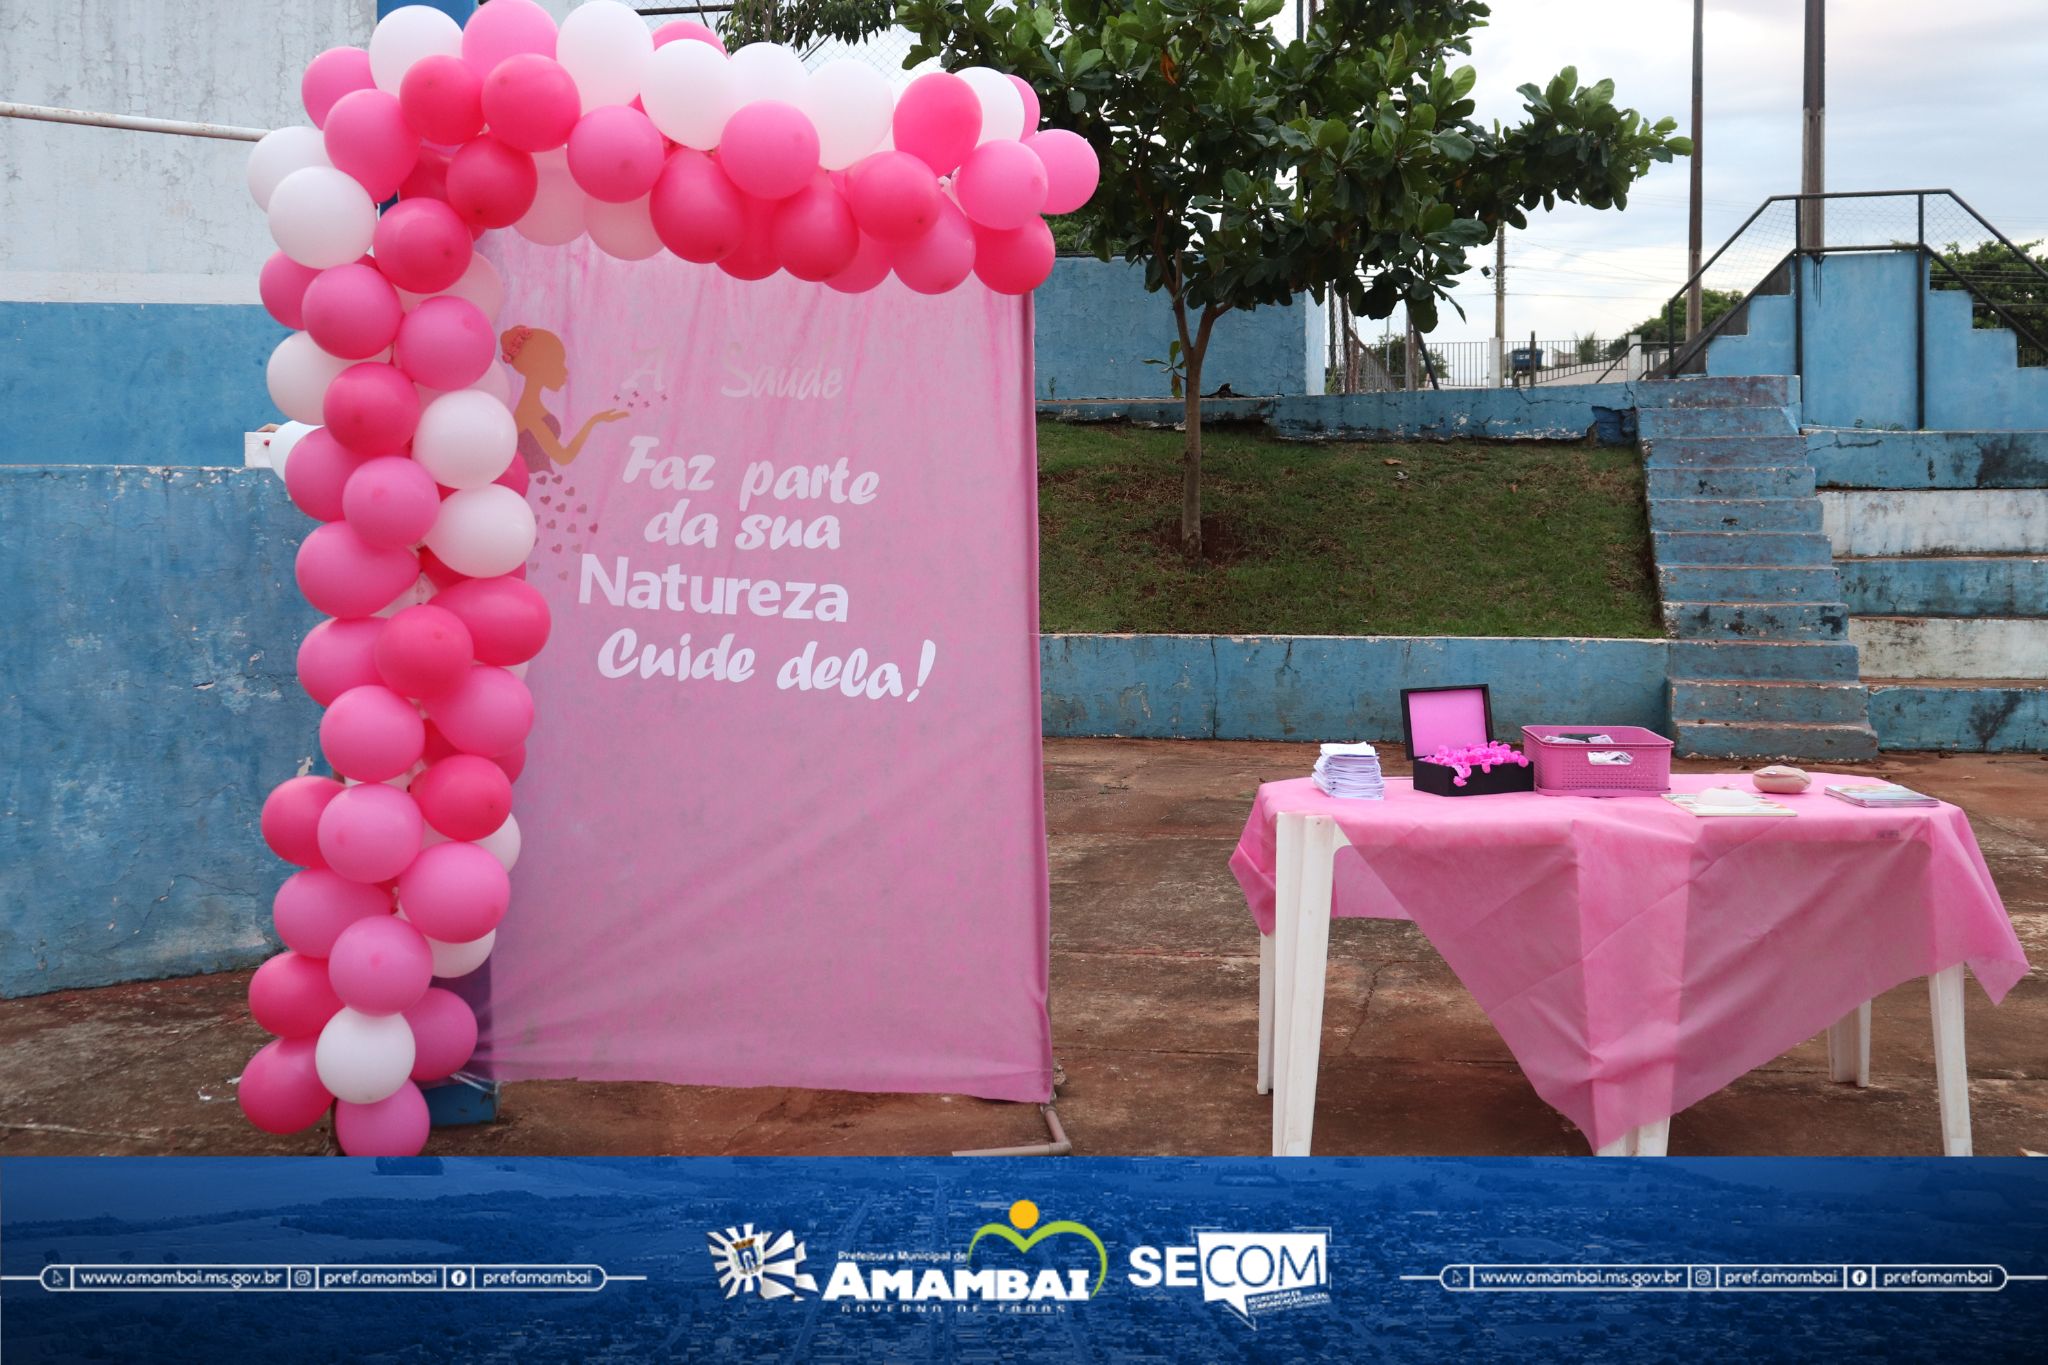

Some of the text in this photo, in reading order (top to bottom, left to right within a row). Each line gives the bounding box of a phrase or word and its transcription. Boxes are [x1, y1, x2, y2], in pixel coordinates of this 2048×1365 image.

[721, 337, 844, 400] Saúde
[622, 435, 880, 511] Faz parte
[643, 498, 841, 551] da sua
[578, 553, 850, 623] Natureza
[597, 627, 937, 702] Cuide dela!
